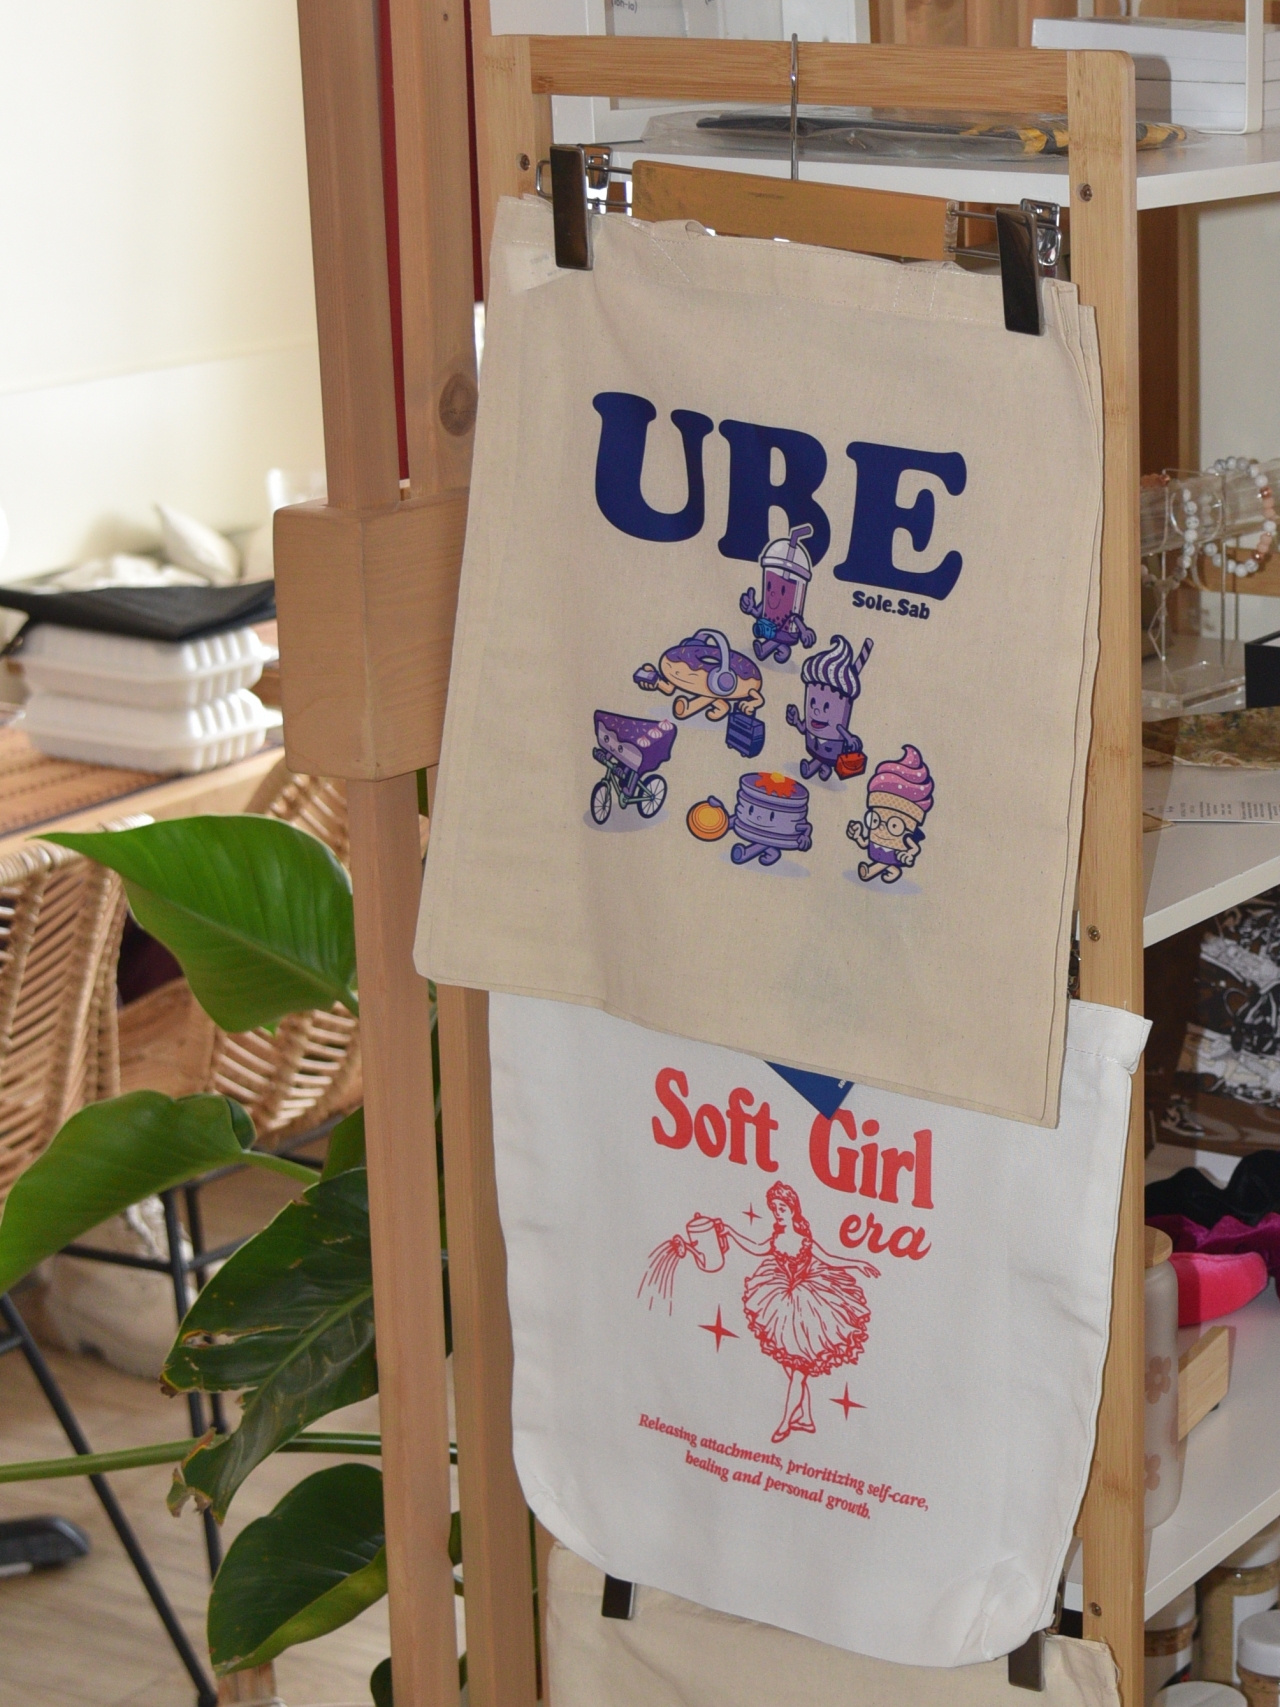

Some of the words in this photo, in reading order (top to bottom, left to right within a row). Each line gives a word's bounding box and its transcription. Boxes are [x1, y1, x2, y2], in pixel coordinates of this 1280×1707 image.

[592, 391, 967, 601] UBE
[852, 590, 930, 620] Sole.Sab
[652, 1067, 779, 1173] Soft
[808, 1108, 934, 1210] Girl
[839, 1212, 932, 1261] era
[638, 1413, 698, 1448] Releasing
[700, 1437, 783, 1471] attachments,
[786, 1459, 865, 1496] prioritizing
[867, 1483, 929, 1512] self-care,
[685, 1450, 729, 1482] healing
[732, 1471, 763, 1486] and
[763, 1475, 824, 1503] personal
[825, 1495, 871, 1520] growth.
